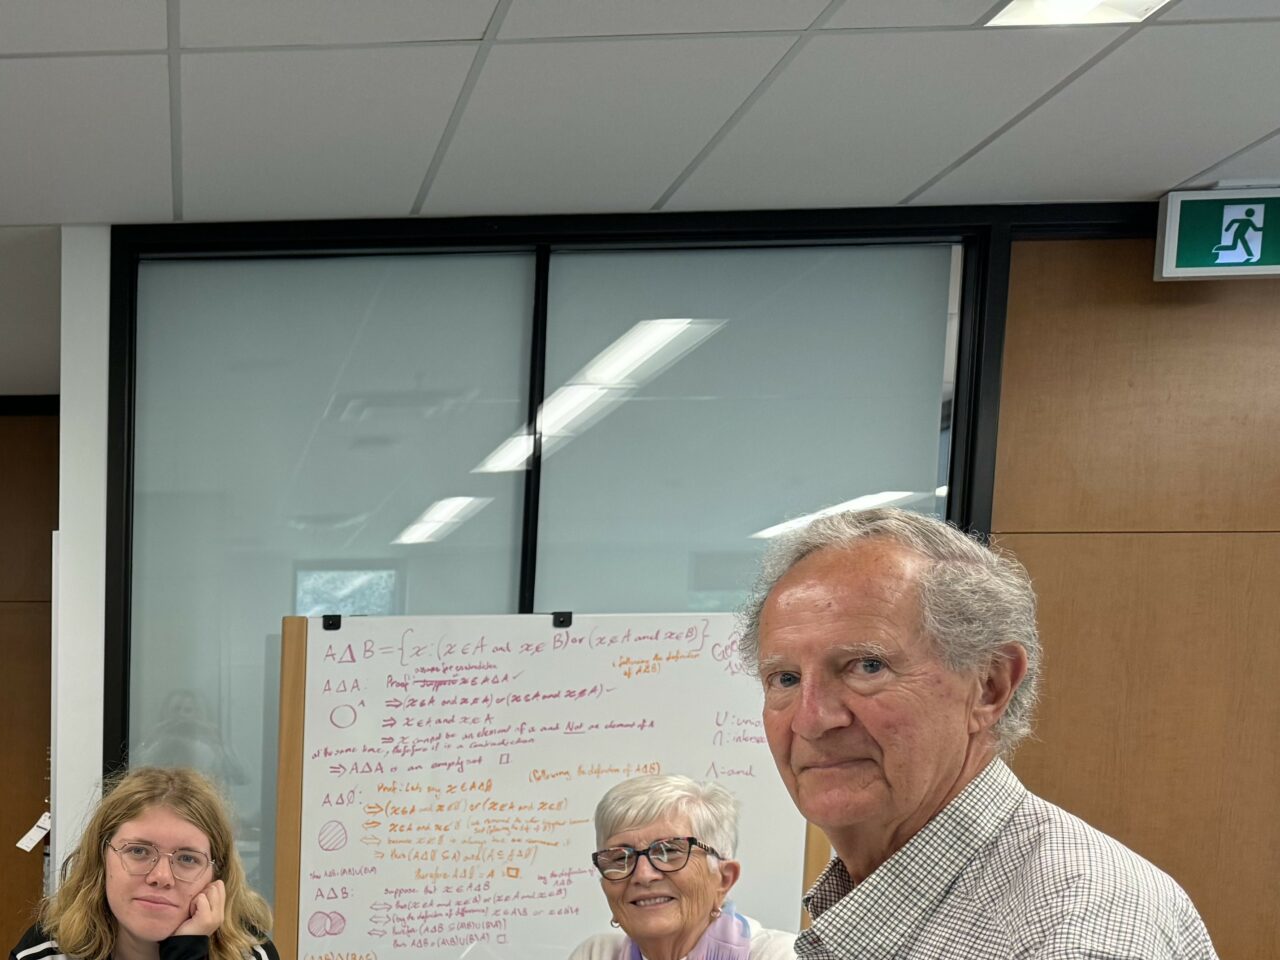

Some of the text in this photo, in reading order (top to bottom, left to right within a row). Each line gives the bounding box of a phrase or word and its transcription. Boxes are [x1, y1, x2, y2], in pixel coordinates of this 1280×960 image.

[492, 641, 511, 653] and
[634, 629, 660, 642] and
[435, 714, 455, 724] and
